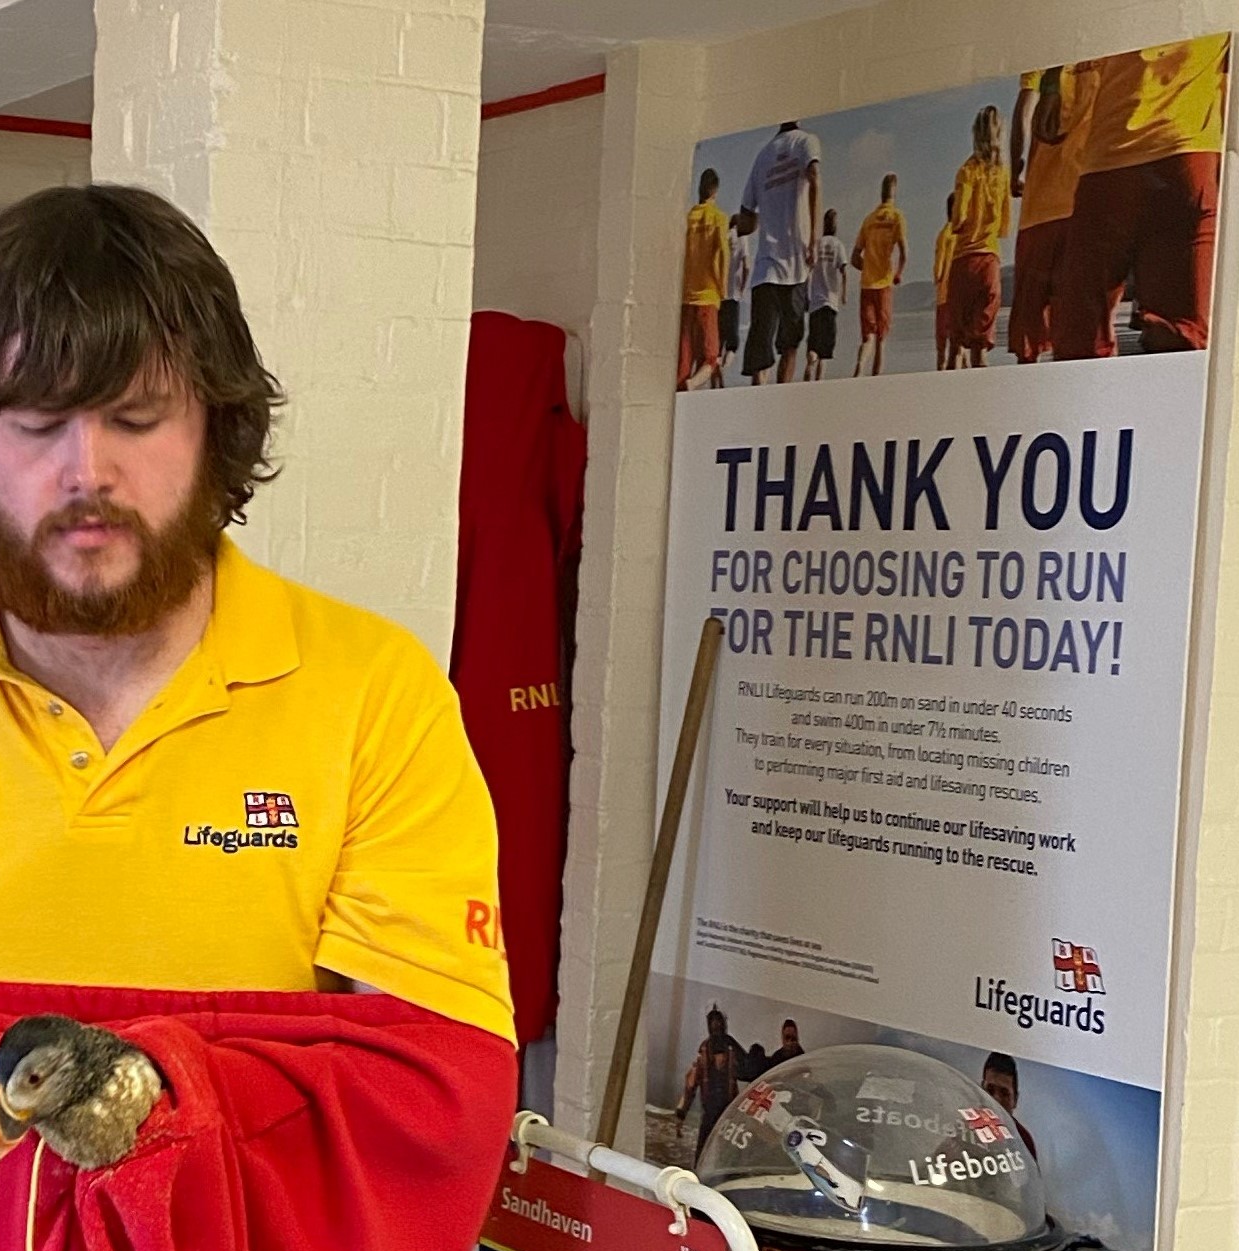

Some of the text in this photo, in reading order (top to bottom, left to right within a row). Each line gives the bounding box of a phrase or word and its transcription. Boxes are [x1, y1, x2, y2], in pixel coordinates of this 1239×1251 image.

[715, 428, 1134, 532] THANK YOU
[711, 550, 1126, 602] FOR CHOOSING TO RUN
[784, 610, 854, 659] THE
[865, 612, 956, 665] RNLI
[968, 616, 1123, 675] TODAY!
[738, 681, 1073, 723] RNLI Lifeguards can run 200m on sand in under 40 seconds
[791, 712, 811, 726] and
[813, 713, 842, 728] swim
[845, 714, 875, 732] 400m
[877, 715, 888, 732] in
[891, 720, 925, 736] under
[948, 723, 1001, 744] minutes.
[735, 727, 1070, 777] They train for every situation, from locating missing children
[754, 757, 1042, 804] to performing major first aid and lifesaving rescues.
[184, 826, 298, 853] Lifeguards
[725, 788, 1076, 852] Your support will help us to continue our lifesaving work
[751, 820, 1038, 876] and keep our lifeguards running to the rescue.
[975, 976, 1105, 1034] Lifeguards
[909, 1149, 1026, 1186] Lifeboats
[501, 1187, 592, 1243] Sandhaven
